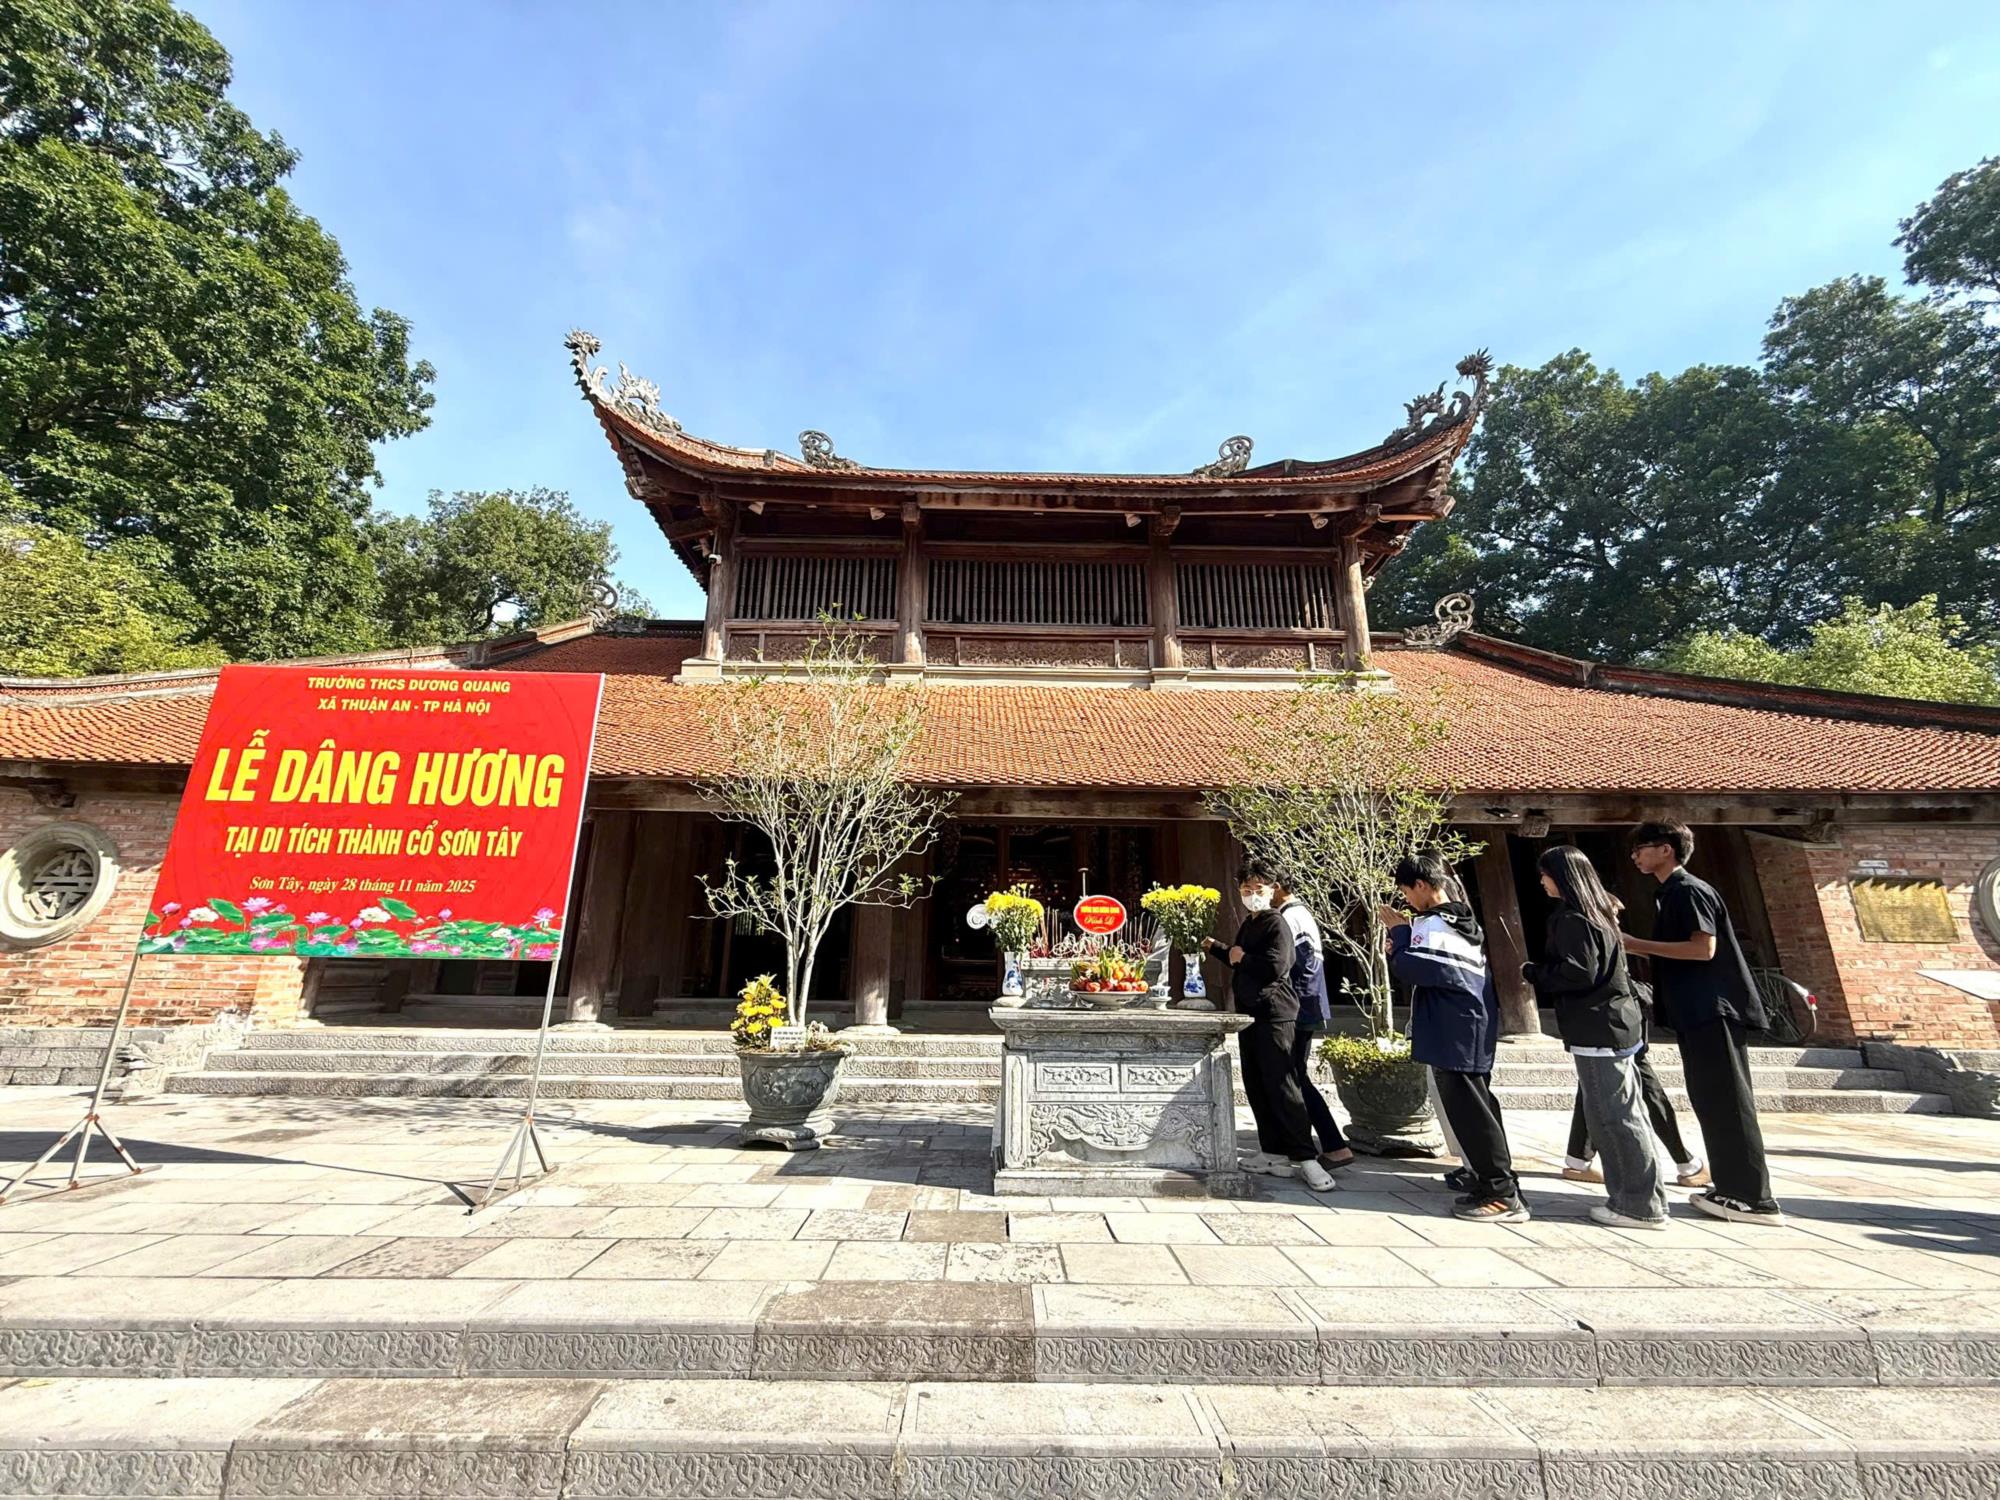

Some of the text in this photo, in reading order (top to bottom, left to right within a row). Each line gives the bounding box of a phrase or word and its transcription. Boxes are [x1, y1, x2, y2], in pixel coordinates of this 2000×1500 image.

[307, 674, 511, 693] TRƯỜNG THCS DƯƠNG QUANG
[317, 696, 337, 710] XÃ
[341, 696, 388, 714] THUẬN
[391, 700, 412, 711] AN
[423, 701, 440, 712] TP
[443, 698, 462, 713] HÀ
[465, 699, 491, 716] NỘI
[205, 729, 565, 807] LỄ DÂNG HƯƠNG
[225, 819, 523, 858] TẠI DI TÍCH THÀNH CỔ SƠN TÂY
[249, 876, 477, 894] Sơn Tây, ngày 28 tháng 11 năm 2025
